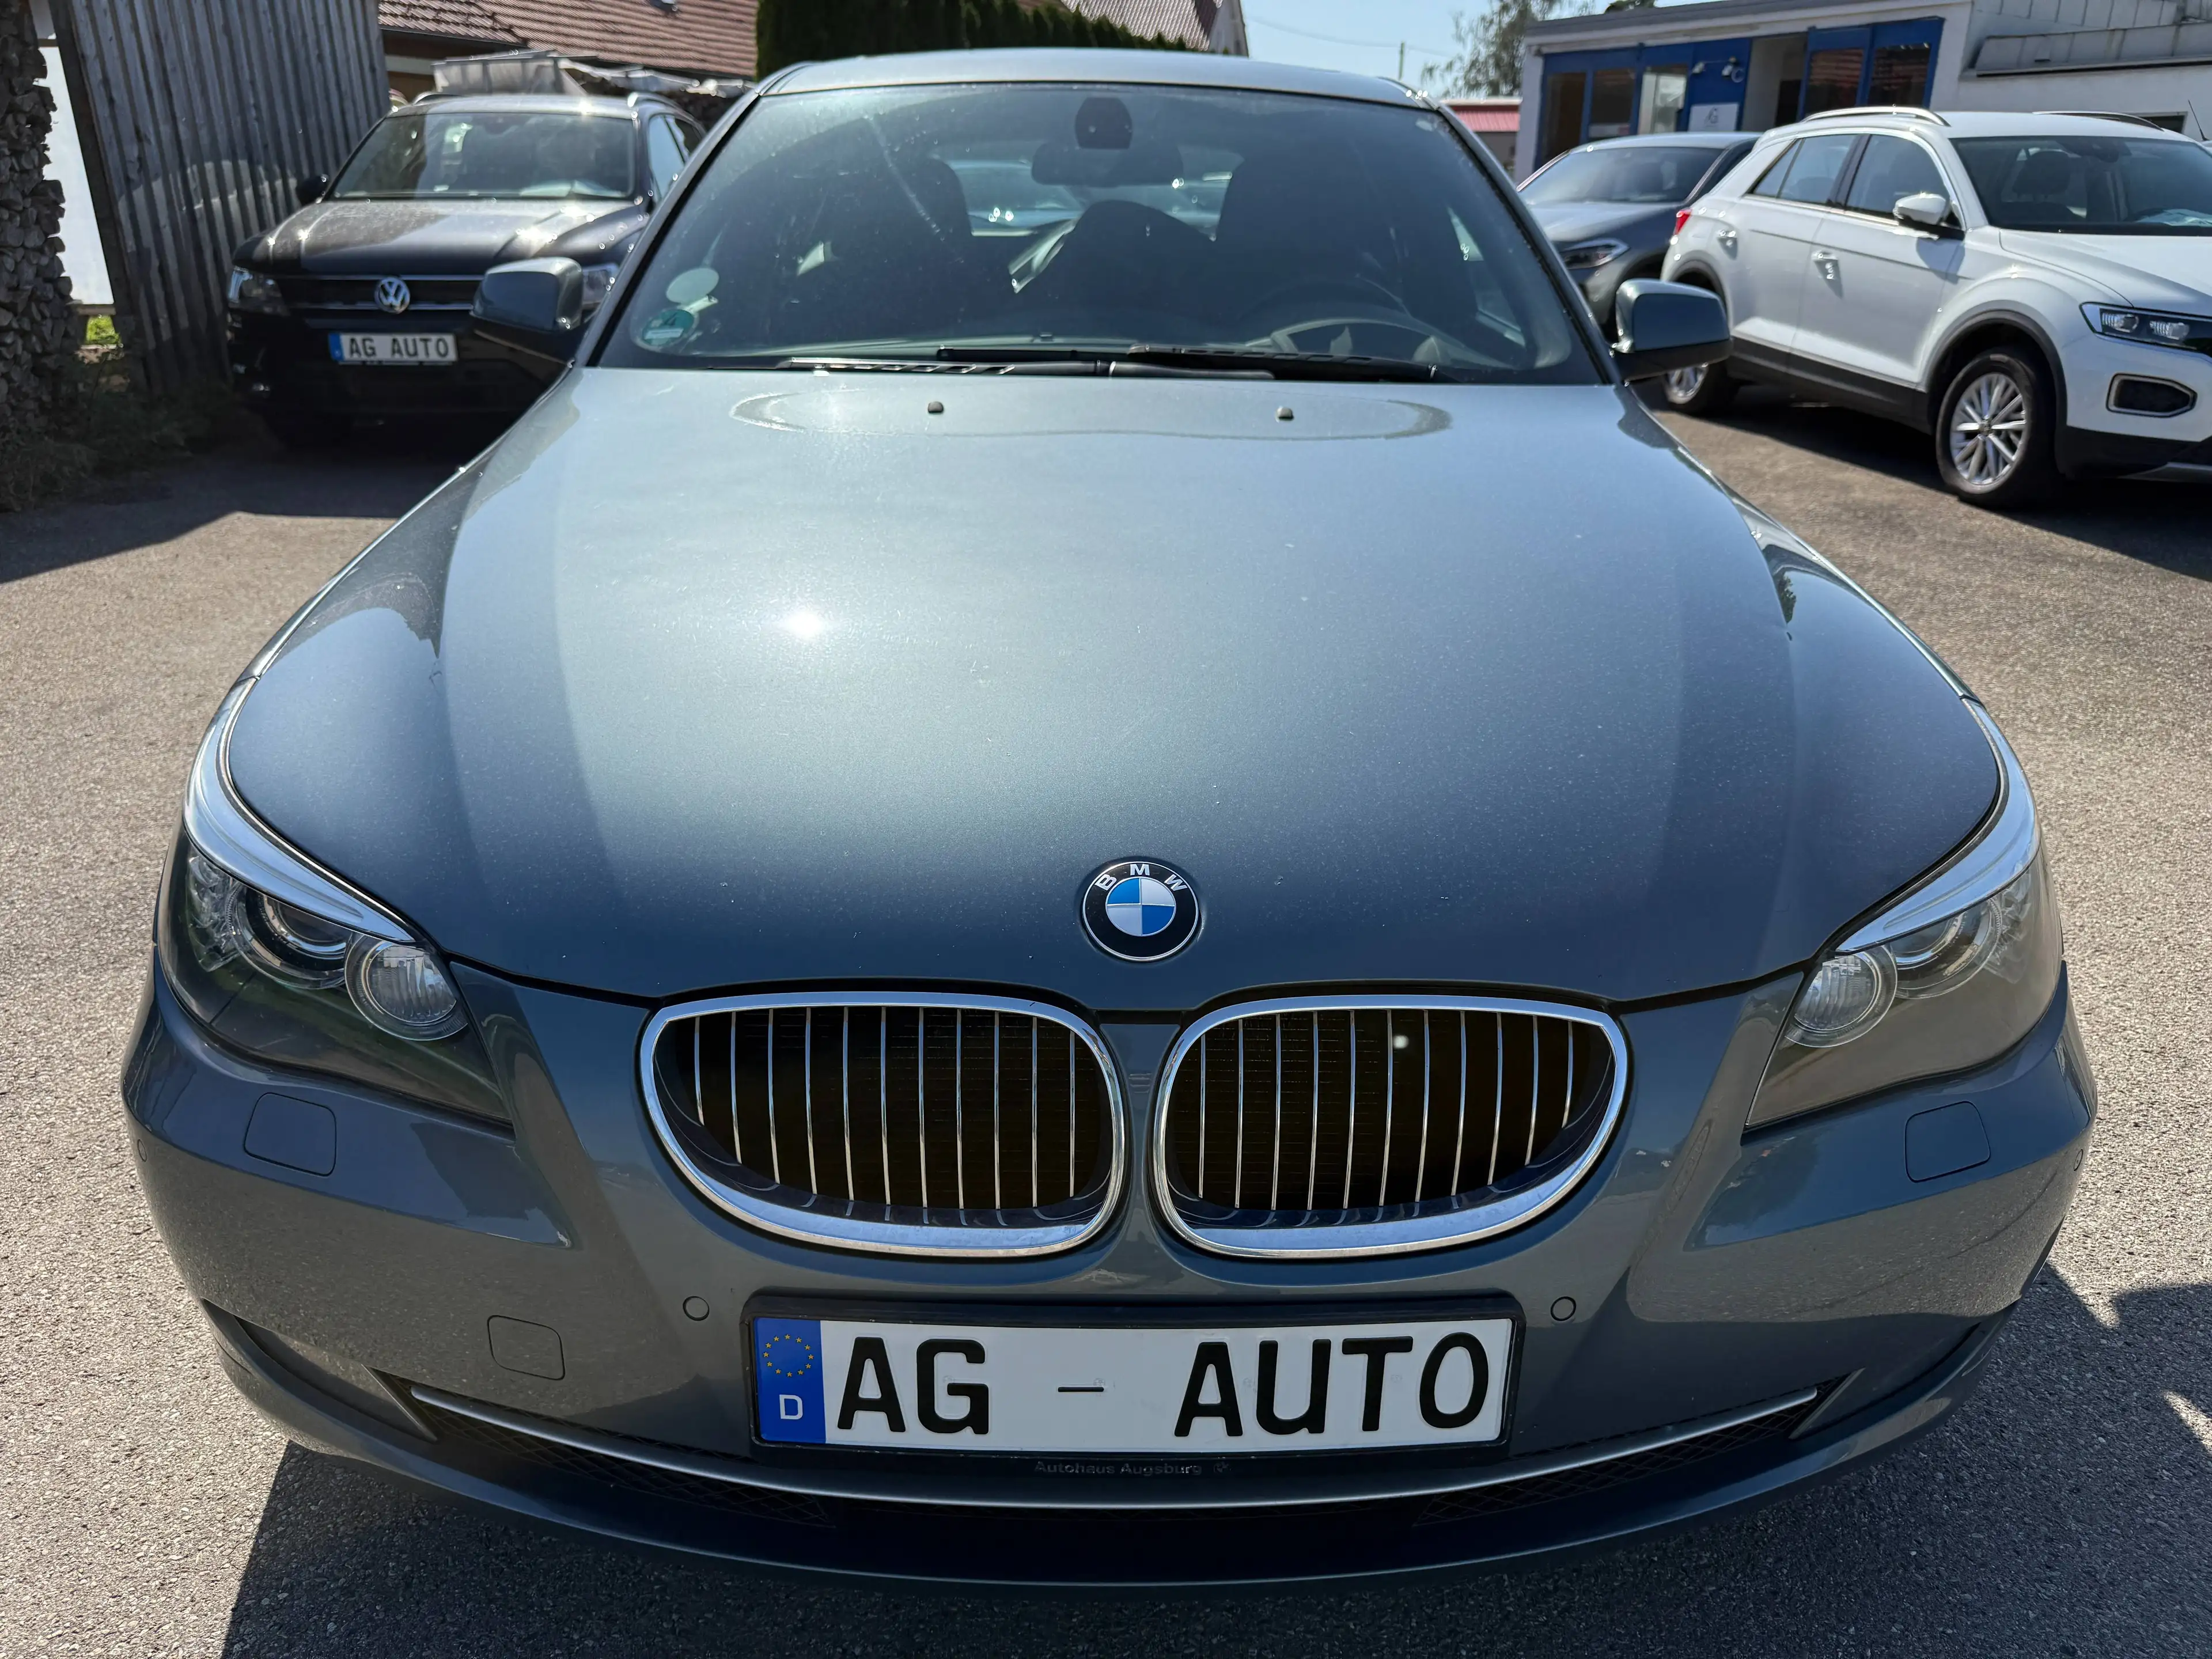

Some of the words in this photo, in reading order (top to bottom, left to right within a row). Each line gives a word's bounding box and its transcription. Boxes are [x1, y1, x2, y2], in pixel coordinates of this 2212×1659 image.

[349, 337, 377, 358] AG
[391, 337, 449, 358] AUTO
[1094, 863, 1188, 892] BMW
[837, 1336, 990, 1435] AG
[1173, 1331, 1490, 1437] AUTO
[779, 1393, 804, 1420] D
[1033, 1461, 1116, 1474] Autohaus
[1119, 1463, 1203, 1476] Augsburg
